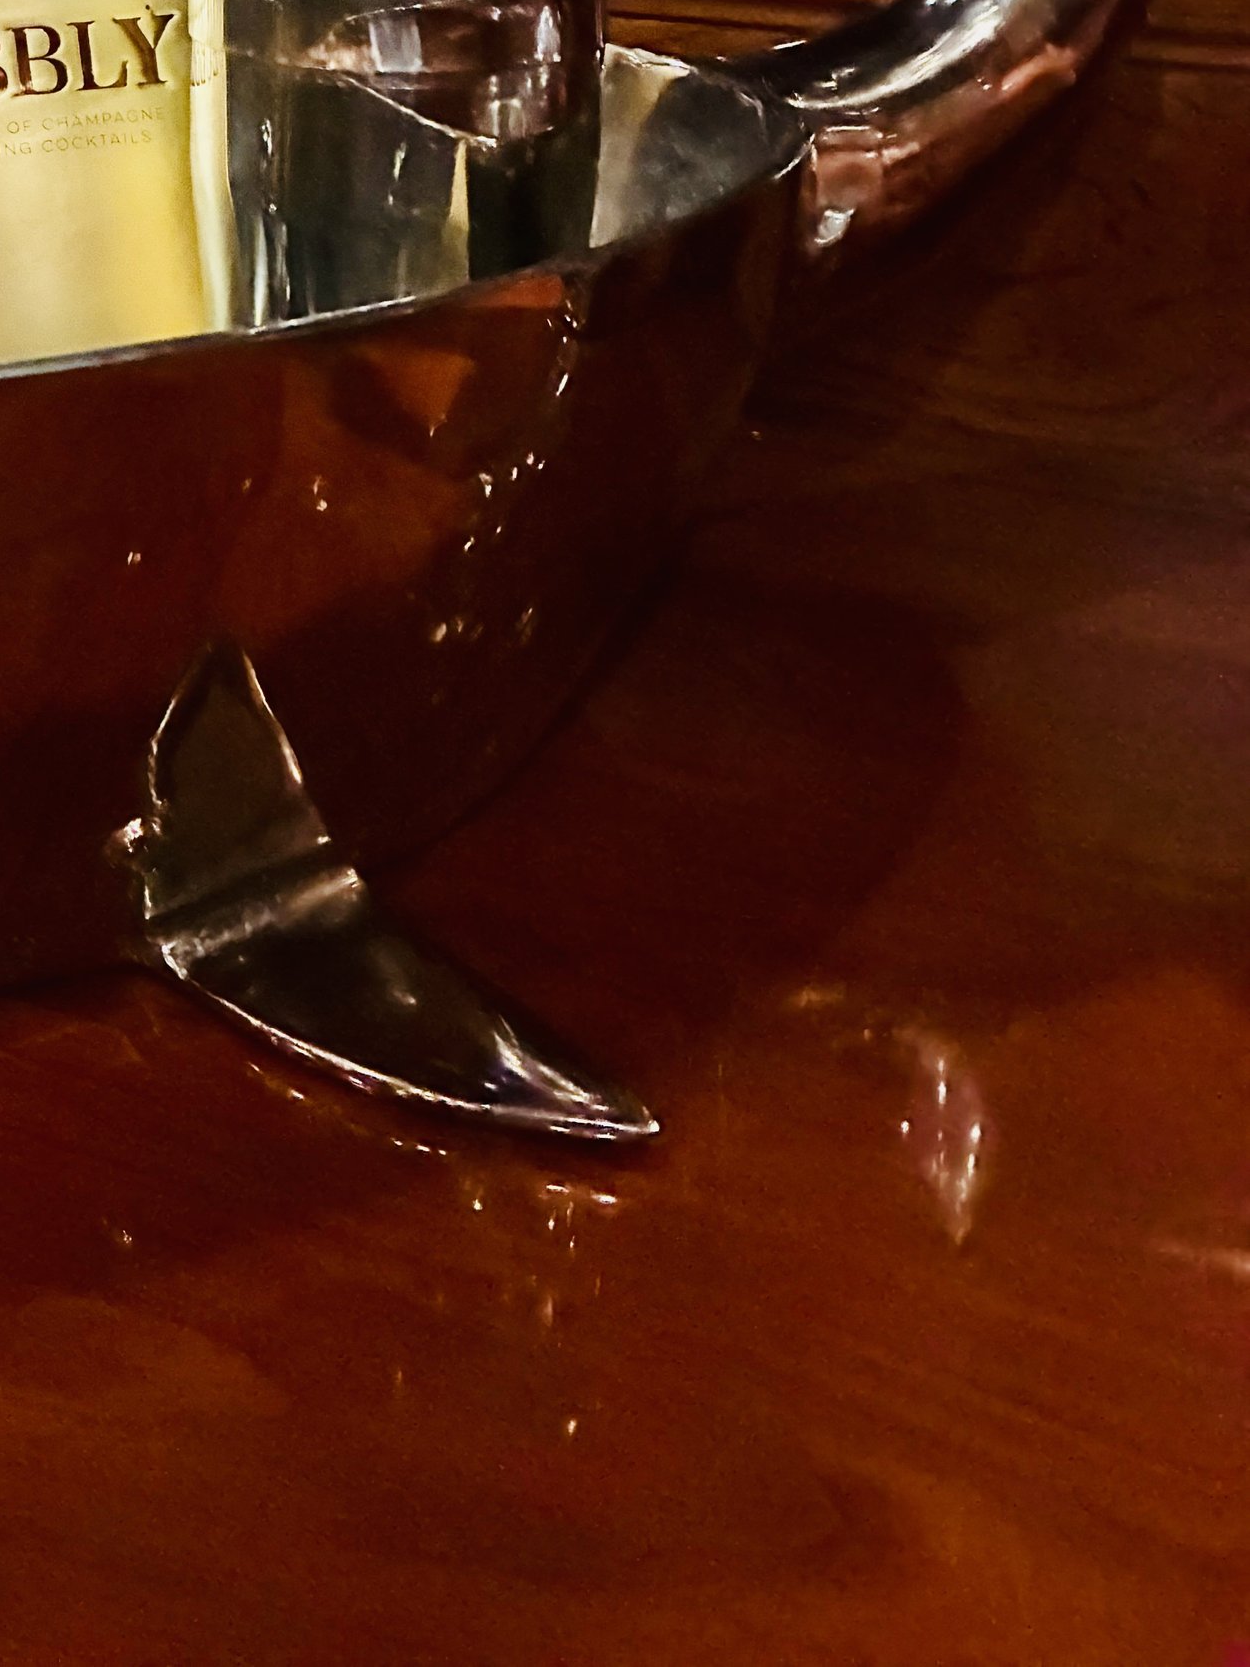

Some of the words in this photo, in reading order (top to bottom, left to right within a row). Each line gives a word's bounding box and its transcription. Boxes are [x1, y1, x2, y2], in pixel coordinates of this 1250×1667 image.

[6, 119, 32, 135] OF
[41, 106, 166, 132] CHAMPAGNE
[41, 129, 153, 153] COCKTAILS
